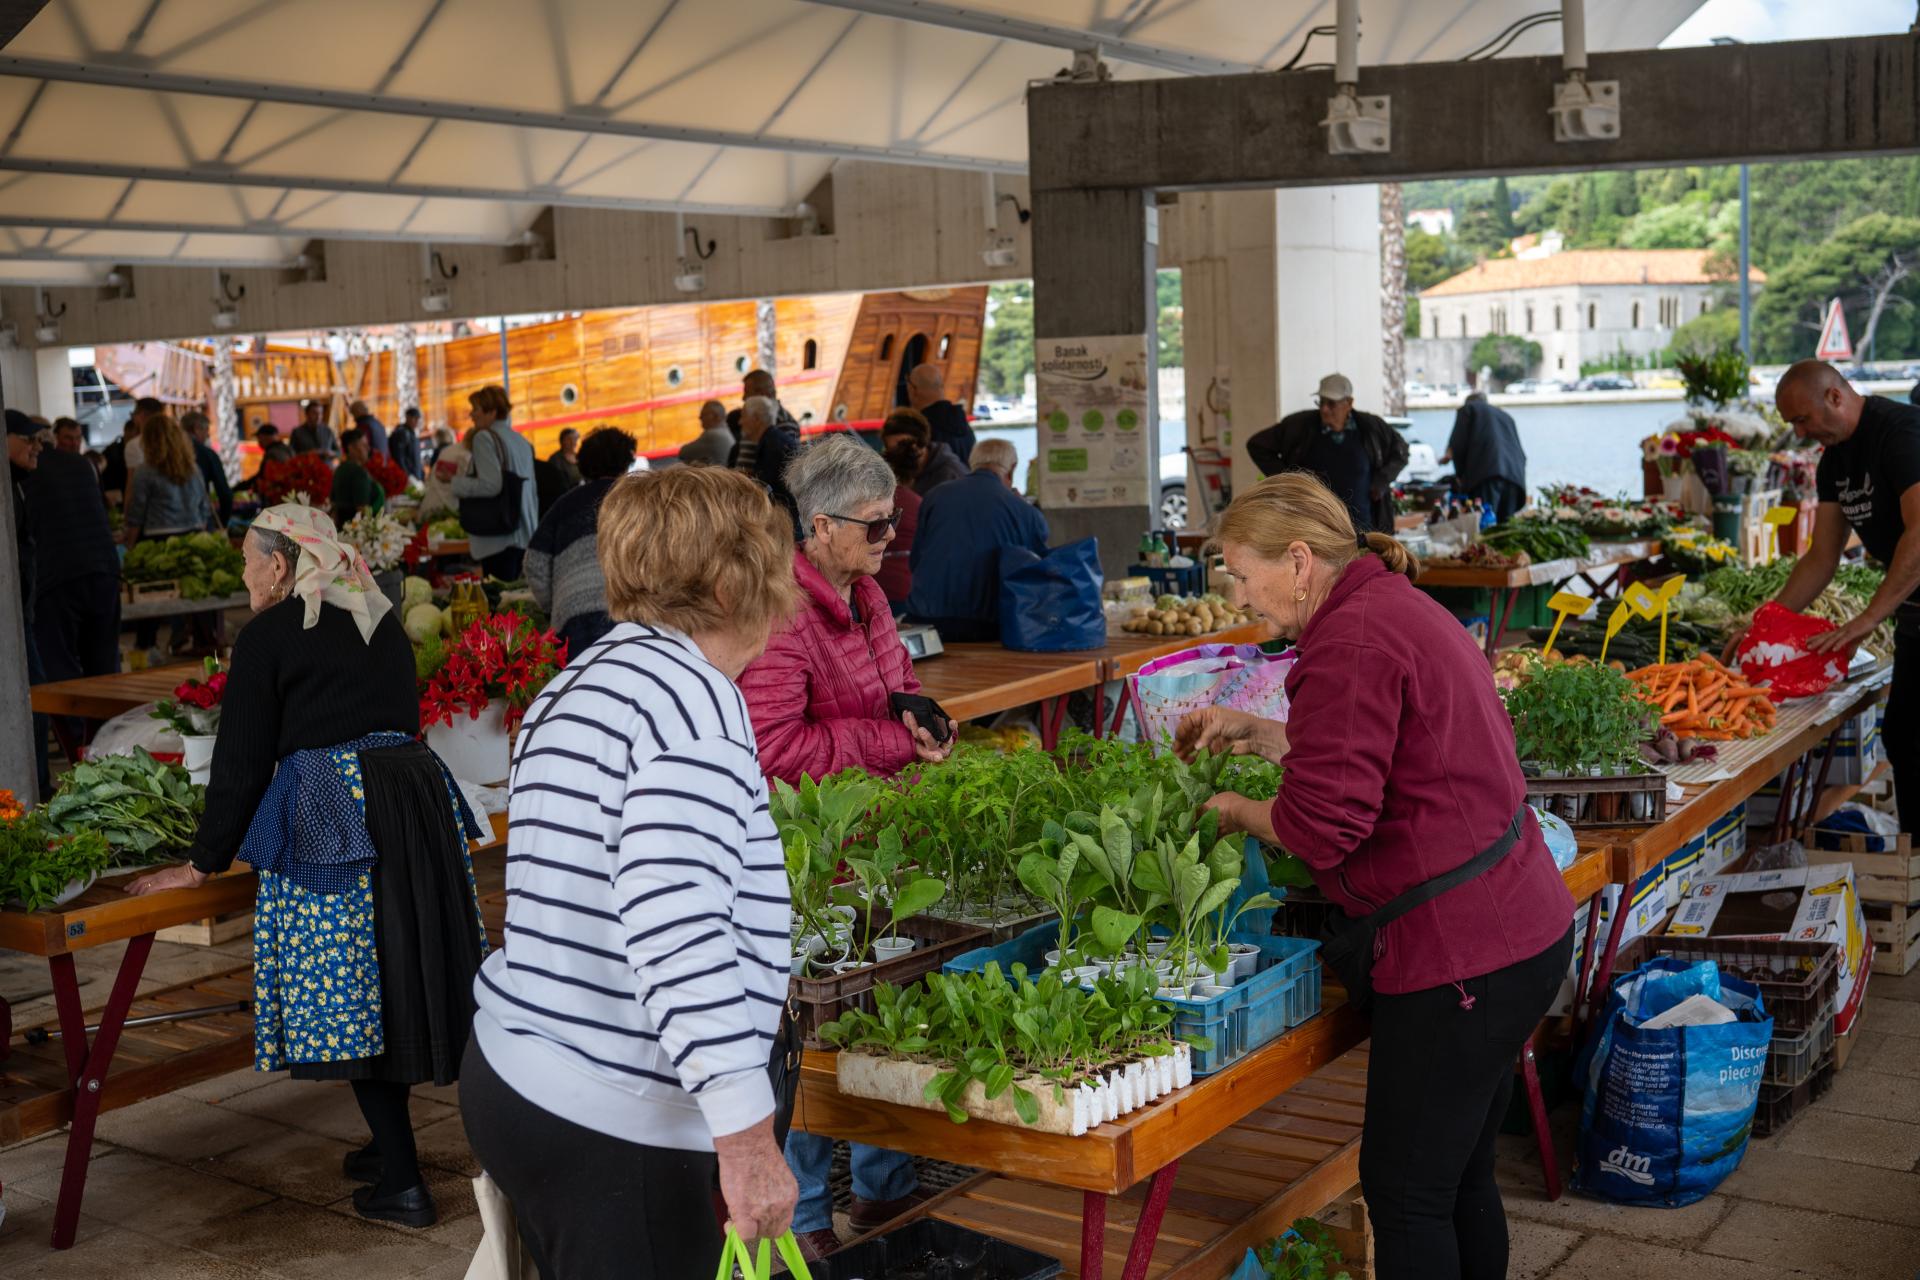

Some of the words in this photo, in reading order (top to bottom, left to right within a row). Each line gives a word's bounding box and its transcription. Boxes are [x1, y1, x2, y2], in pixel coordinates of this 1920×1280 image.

[1055, 344, 1088, 357] Banak
[1041, 359, 1103, 372] solidarnosti
[1720, 1065, 1750, 1085] piece
[1608, 1145, 1651, 1173] dm
